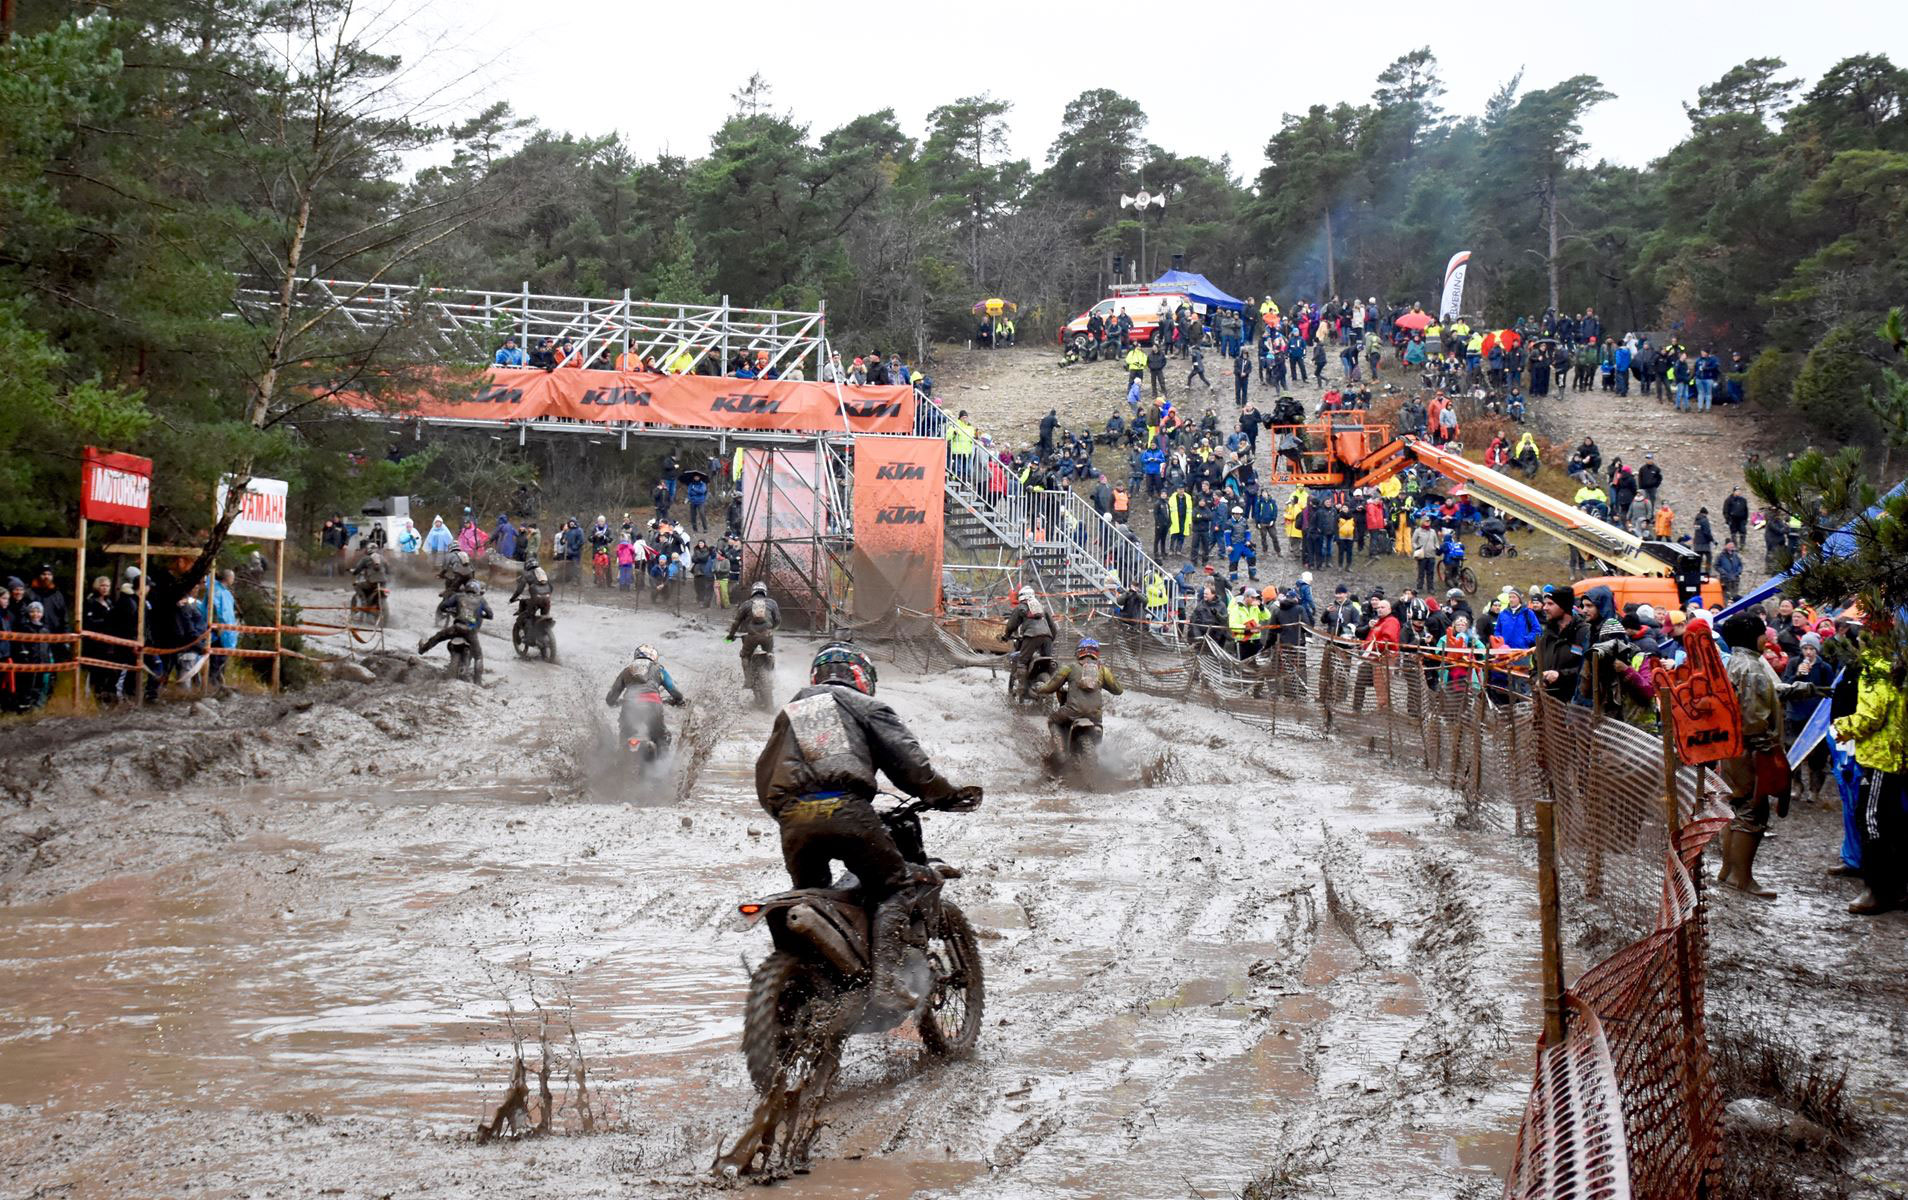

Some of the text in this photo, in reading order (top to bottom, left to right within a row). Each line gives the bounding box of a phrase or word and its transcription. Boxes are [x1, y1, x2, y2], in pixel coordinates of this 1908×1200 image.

[580, 386, 652, 406] KTM
[710, 393, 782, 414] KTM
[835, 399, 901, 417] KTM
[875, 462, 926, 480] KTM
[240, 493, 284, 524] YAMAHA
[875, 506, 926, 525] KTM
[1687, 727, 1730, 748] KTM
